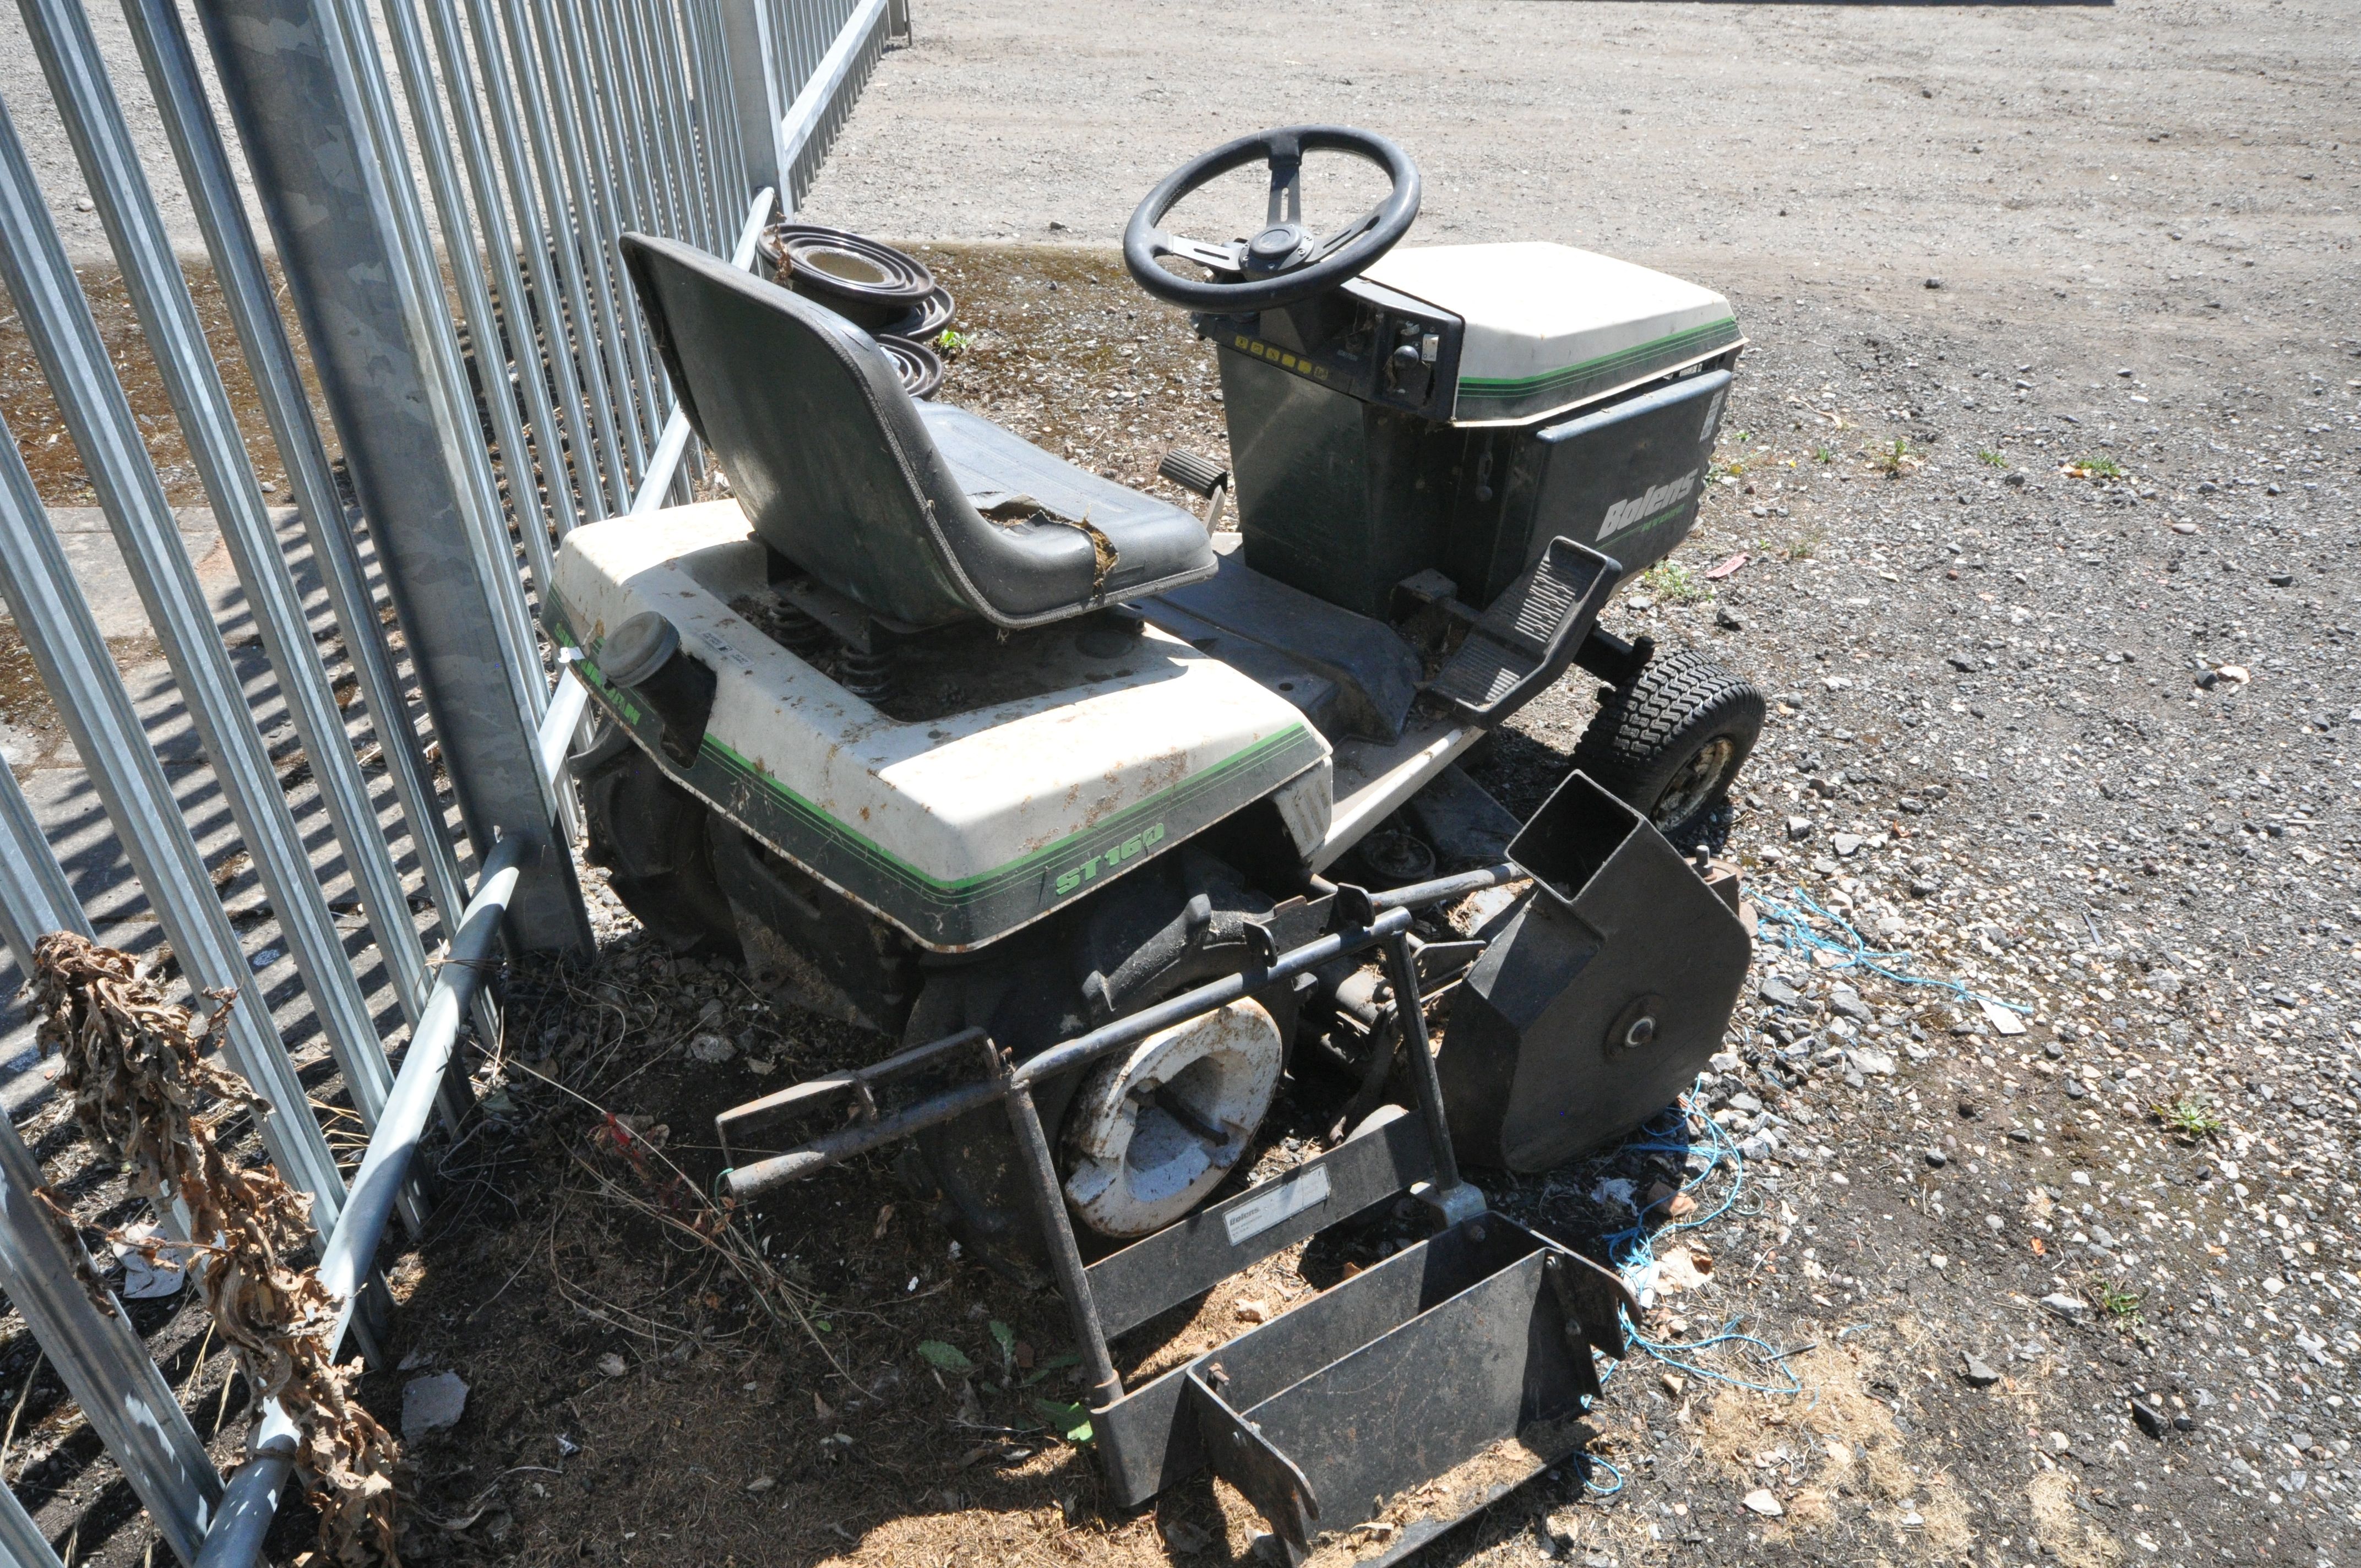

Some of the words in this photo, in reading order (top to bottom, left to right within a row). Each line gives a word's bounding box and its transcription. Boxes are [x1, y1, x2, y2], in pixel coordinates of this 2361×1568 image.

[1595, 469, 1699, 542] Bolens
[1056, 855, 1101, 896] ST
[1104, 823, 1165, 868] 160
